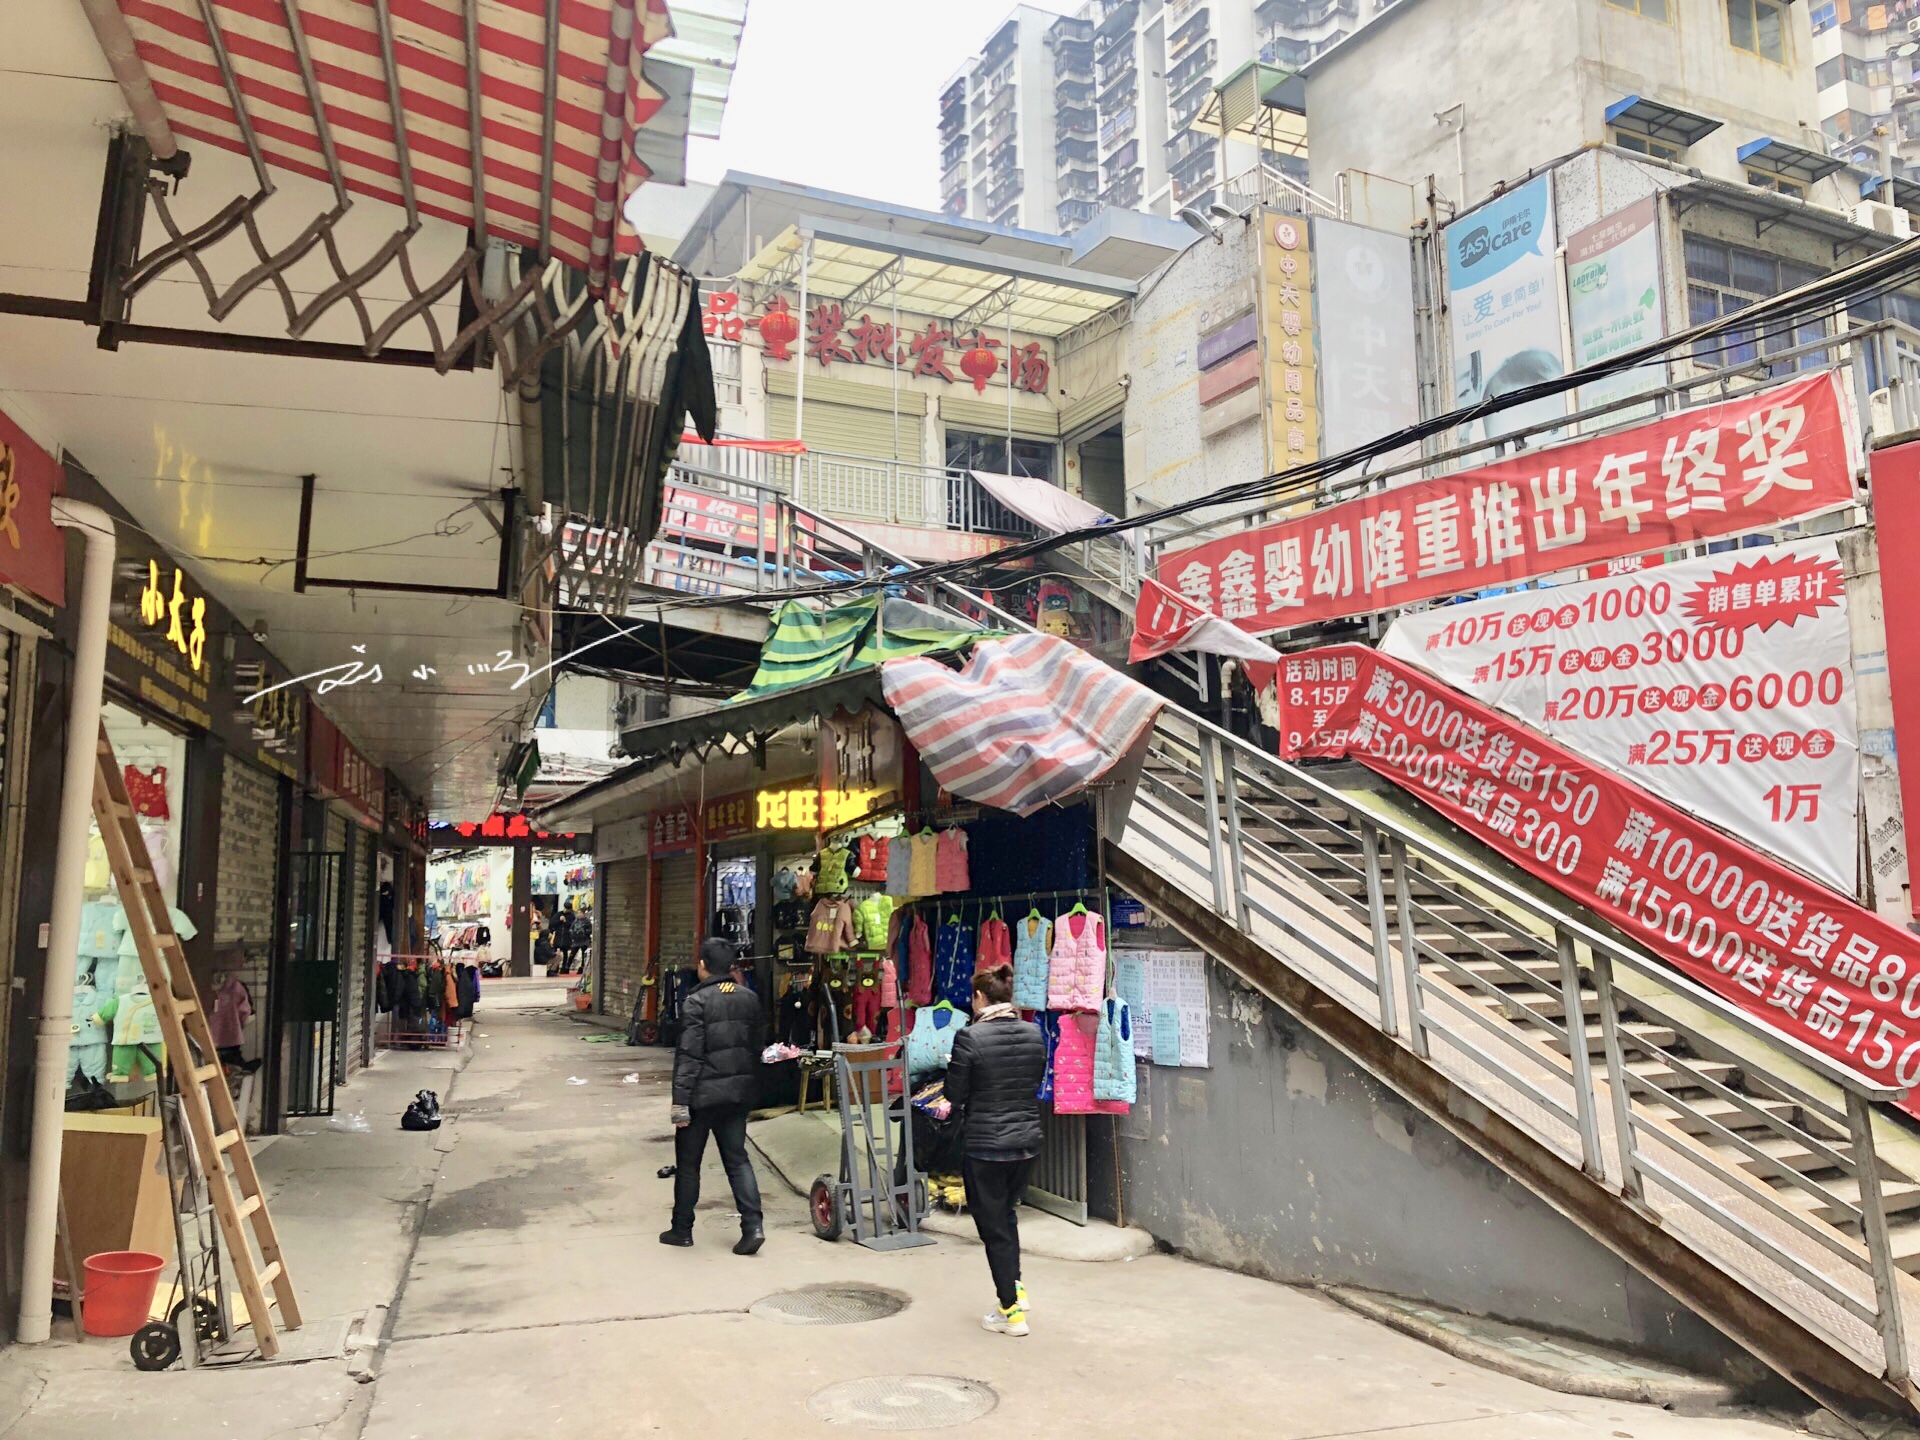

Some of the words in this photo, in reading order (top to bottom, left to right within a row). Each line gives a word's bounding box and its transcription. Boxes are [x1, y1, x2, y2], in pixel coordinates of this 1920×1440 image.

[703, 292, 1051, 394] 品装批发场
[1177, 403, 1813, 620] 鑫鑫婴幼隆重推出年终奖
[1708, 572, 1827, 614] 销售单累计
[1285, 656, 1358, 684] 活动时间
[1289, 686, 1350, 707] 8.15日
[1312, 709, 1328, 729] 至
[1364, 665, 1599, 827] 满3000送货品150
[1349, 708, 1582, 876] 满5000送货品300
[1763, 784, 1822, 823] 1万
